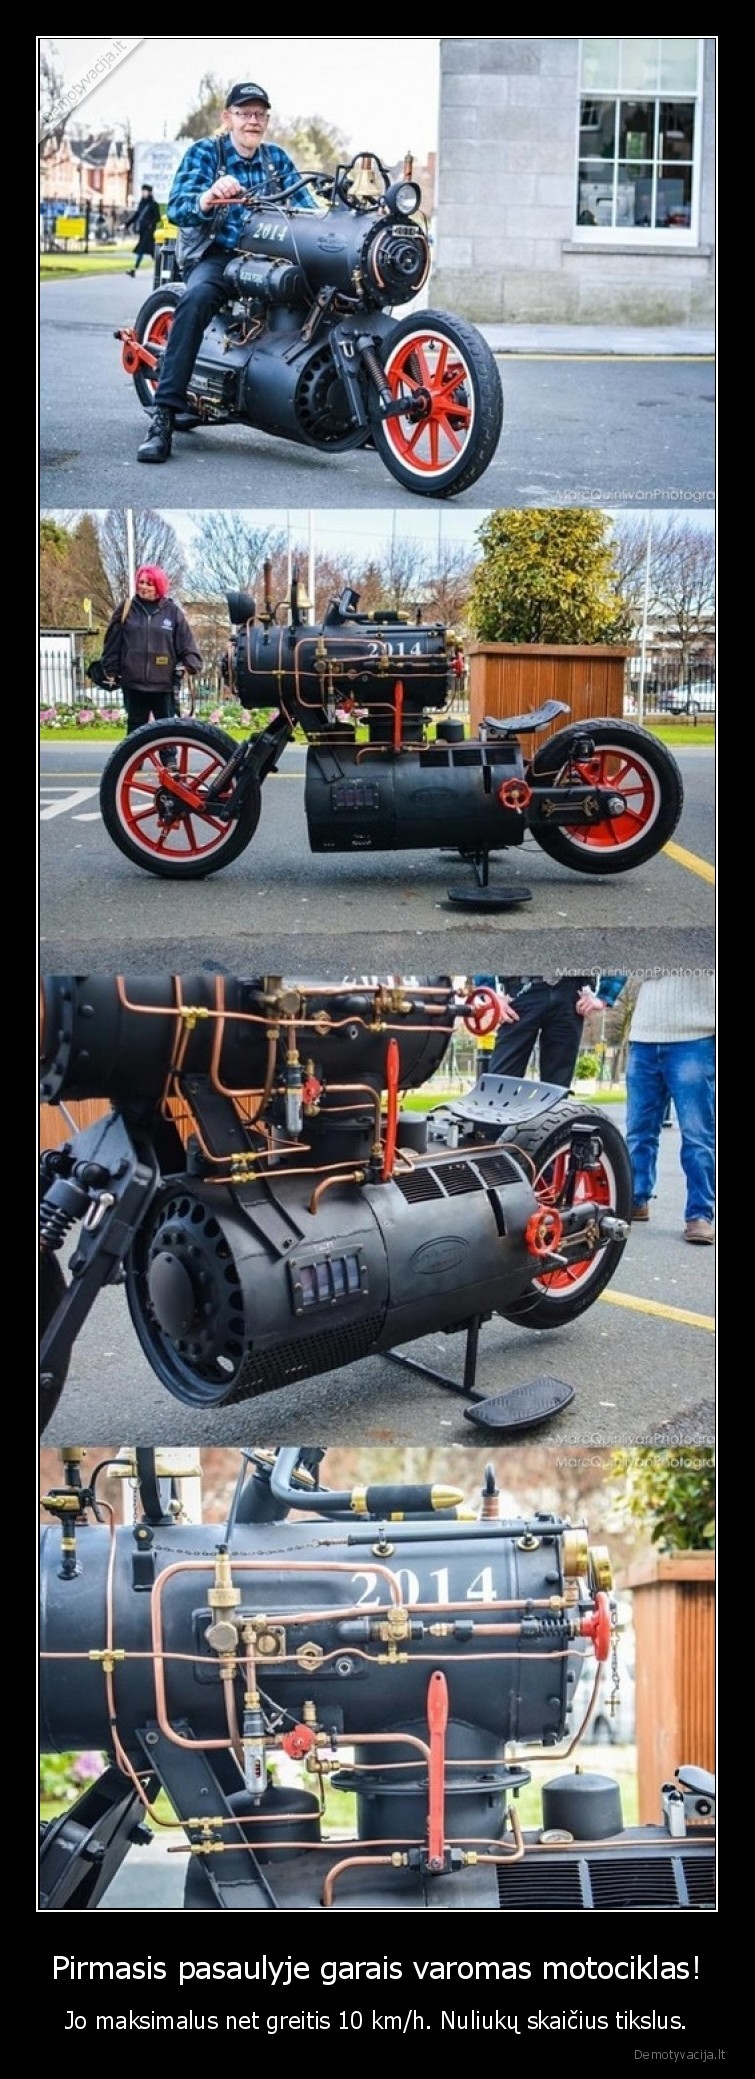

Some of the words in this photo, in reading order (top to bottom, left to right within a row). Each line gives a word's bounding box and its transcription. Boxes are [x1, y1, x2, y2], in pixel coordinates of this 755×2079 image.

[252, 222, 289, 242] 2014
[367, 641, 422, 658] 2014
[351, 1566, 498, 1608] 2014
